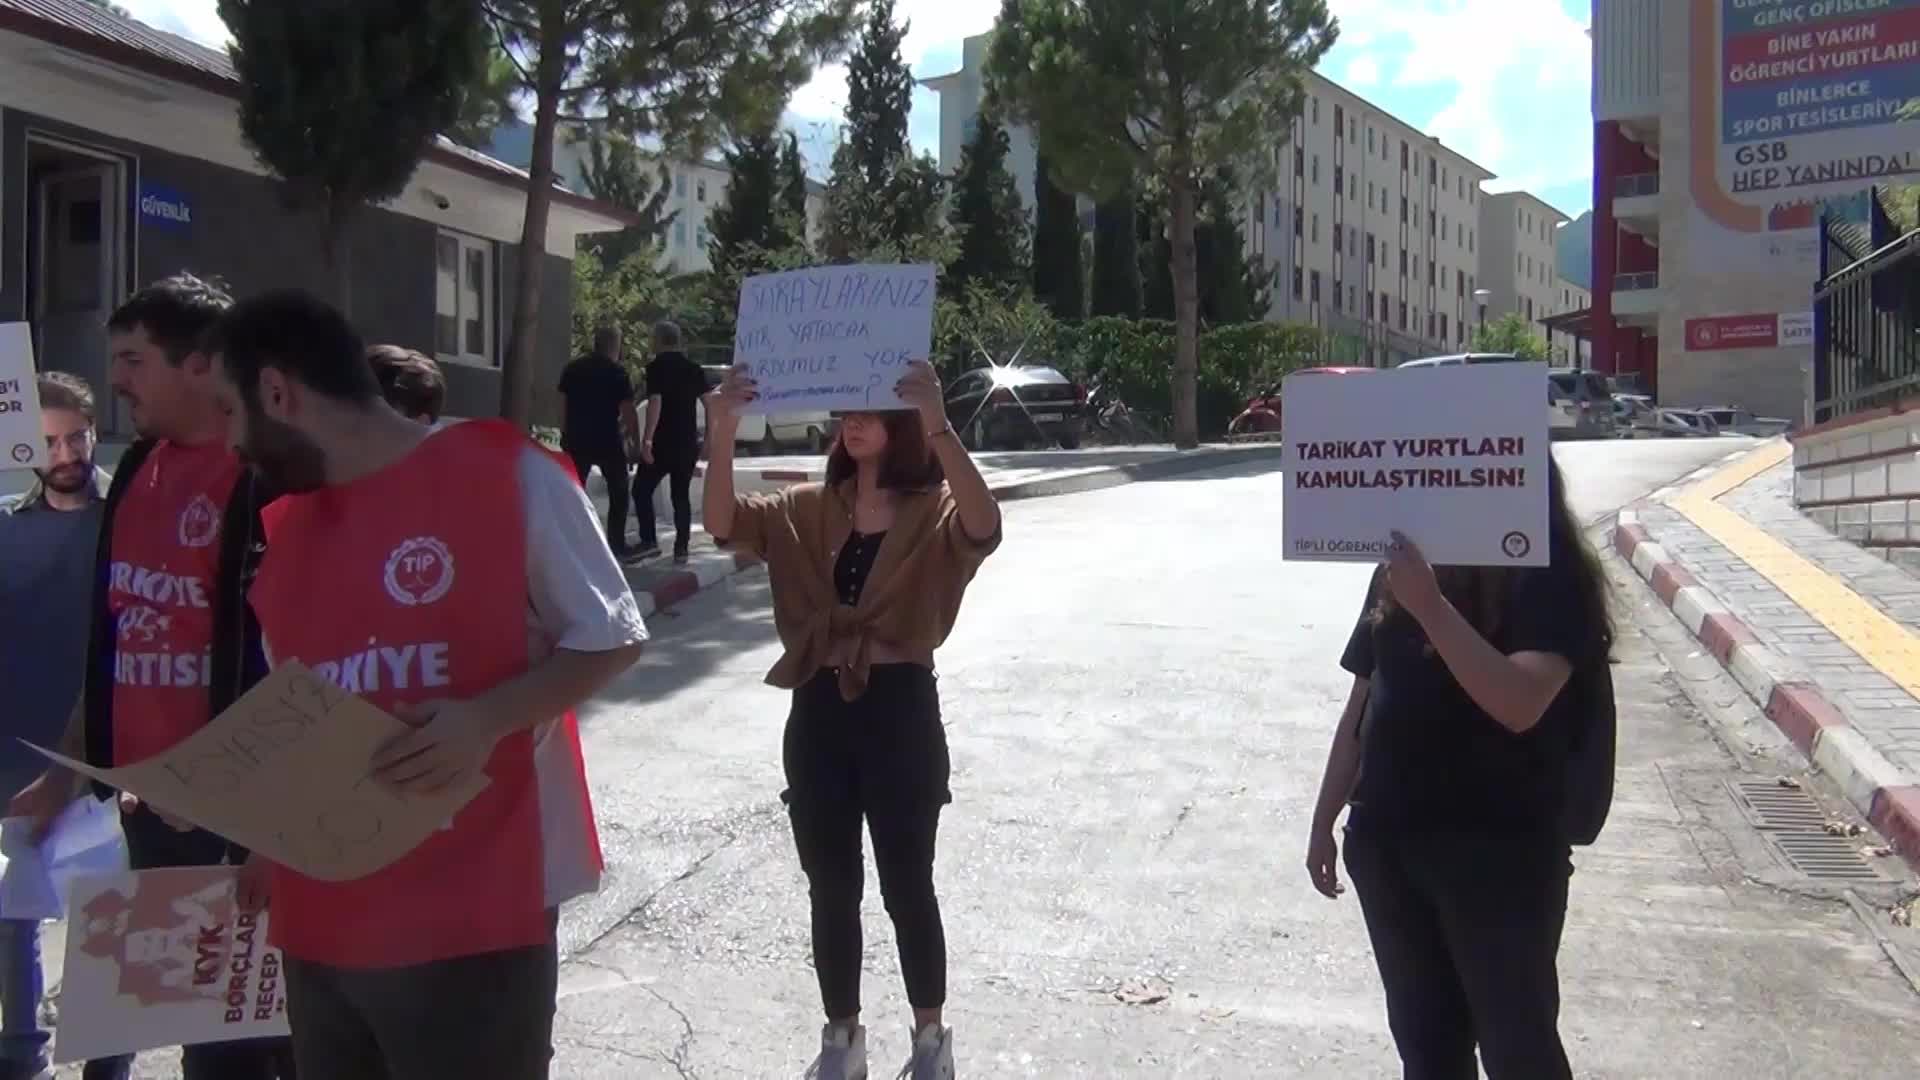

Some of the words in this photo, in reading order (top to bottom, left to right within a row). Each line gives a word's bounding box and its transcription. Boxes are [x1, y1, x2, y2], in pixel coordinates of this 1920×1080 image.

[1754, 5, 1805, 26] GENÇ
[1767, 33, 1813, 55] BİNE
[1816, 23, 1876, 47] YAKIN
[1730, 53, 1815, 82] ÖĞRENCİ
[1817, 40, 1917, 70] YURTLARI
[1777, 79, 1871, 107] BİNLERCE
[1732, 115, 1784, 137] SPOR
[1735, 141, 1787, 165] GSB
[1732, 169, 1779, 192] HEP
[1296, 440, 1386, 460] TARİKAT
[1393, 436, 1525, 458] YURTLARI
[1296, 468, 1526, 491] KAMULAŞTIRILSIN!
[109, 560, 209, 608] RKİYE
[317, 637, 450, 693] RKİYE
[192, 924, 225, 985] KYK
[225, 912, 257, 1023] BORÇLAR
[255, 952, 279, 1021] RECEP
